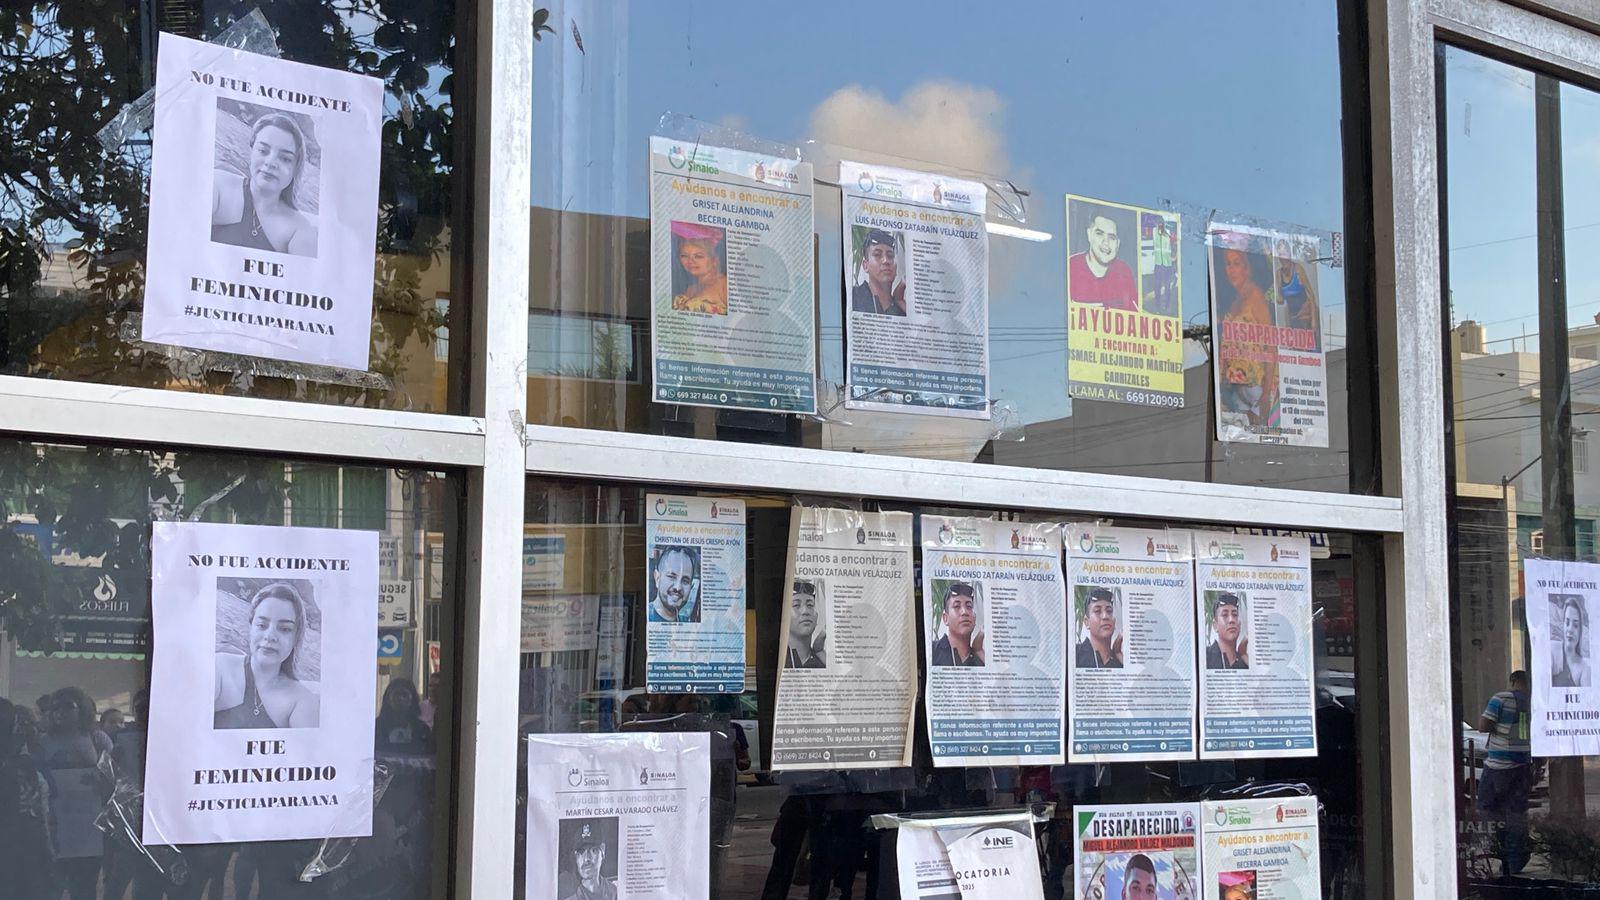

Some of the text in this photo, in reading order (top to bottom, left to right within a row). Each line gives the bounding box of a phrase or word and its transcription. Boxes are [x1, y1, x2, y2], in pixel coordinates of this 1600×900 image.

[190, 70, 352, 113] NO FUE ACCIDENTE
[688, 161, 719, 175] Sinaloa
[739, 192, 788, 208] encontrar
[944, 191, 971, 200] SINALOA
[692, 199, 775, 219] GRISET ALEJANDRINA
[697, 213, 771, 232] BECERRA GAMBOA
[855, 215, 870, 225] LUIS
[870, 217, 903, 229] ALFONSO
[904, 222, 939, 235] ZATARAÍN
[919, 212, 964, 226] encontrar
[242, 258, 285, 278] FUE
[190, 277, 334, 312] FEMINICIDIO
[184, 304, 335, 336] #JUSTICIAPARAANA
[1094, 338, 1158, 356] A ENCONTRAR A:
[1100, 352, 1144, 369] ALEJANDRO
[1104, 370, 1150, 387] CARRIZALES
[690, 392, 701, 400] 327
[1068, 384, 1185, 408] LLAMA AL: 6691209093
[802, 531, 824, 542] naloa
[868, 530, 896, 539] SINALOA
[1095, 544, 1120, 554] Sinaloa
[187, 554, 350, 571] NO FUE ACCIDENTE
[796, 552, 831, 563] danos
[841, 555, 889, 566] encontrar
[999, 559, 1041, 569] encontrar
[795, 567, 903, 579] LFONSO ZATARAÍN VELÁZQUEZ
[934, 569, 1056, 582] LUIS ALFONSO ZATARAÍN VELÁZQUEZ
[1135, 566, 1173, 575] encontrar
[1258, 571, 1296, 580] encontrar
[1077, 575, 1090, 583] LUIS
[1091, 576, 1120, 585] ALFONSO
[1205, 581, 1218, 589] LUIS
[1218, 581, 1246, 590] ALFONSO
[1536, 579, 1547, 588] NO
[1563, 580, 1598, 590] ACCIDENTE
[1565, 693, 1581, 704] FUE
[1546, 710, 1600, 721] FEMINICIDIO
[796, 726, 833, 735] información
[834, 726, 860, 734] referente
[1545, 728, 1600, 737] #JUSTICIAPARAAN
[246, 740, 286, 756] FUE
[193, 765, 337, 785] FEMINICIDIO
[584, 778, 610, 786] Sinaloa
[187, 794, 339, 812] #JUSTICIAPARAANA
[565, 805, 679, 817] MARTÍN CESAR ALVARADO CHÁVEZ
[1093, 817, 1180, 838] DESAPARECIDO
[992, 836, 1014, 846] INE
[1265, 832, 1302, 842] encontrar
[1232, 845, 1292, 857] GRISET ALEJANDRINA
[1236, 858, 1289, 869] BECERRA GAMBOA
[955, 867, 1011, 880] OCATORIA
